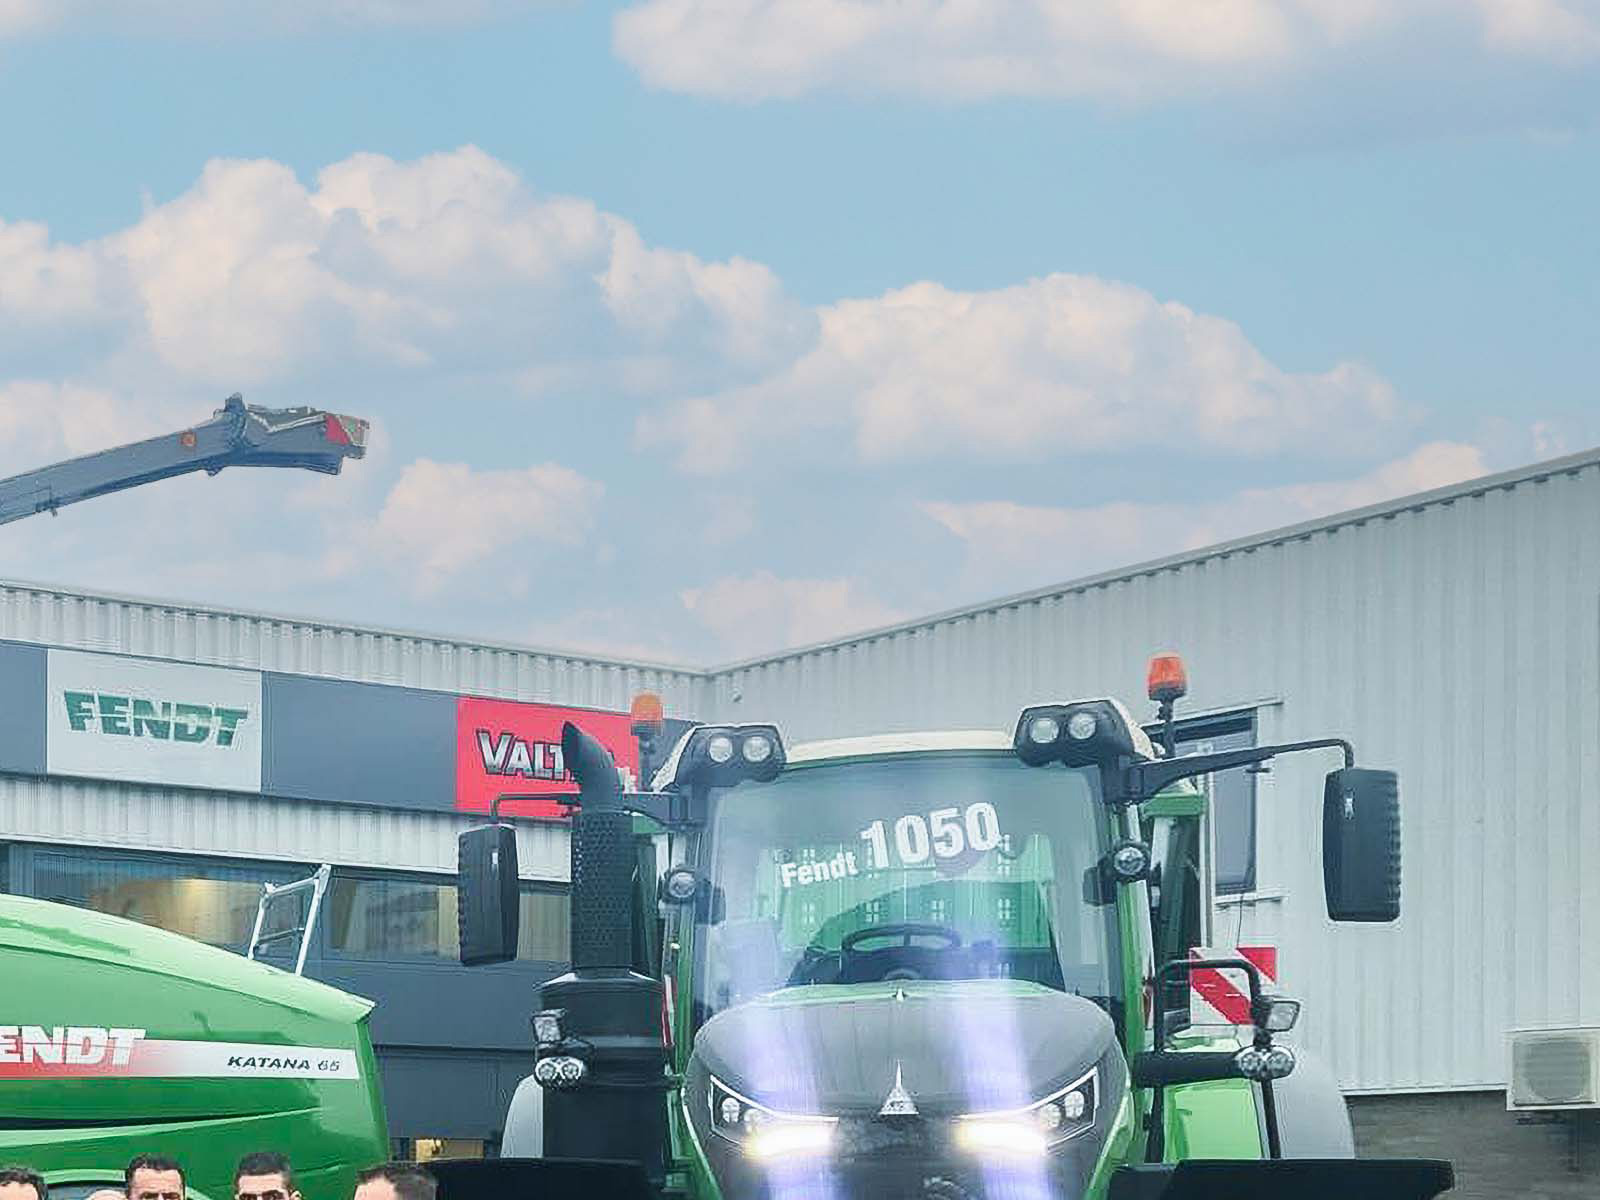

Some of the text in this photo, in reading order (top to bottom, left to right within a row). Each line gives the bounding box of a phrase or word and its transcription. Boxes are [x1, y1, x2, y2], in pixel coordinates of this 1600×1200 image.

[64, 689, 249, 747] FENDT
[475, 727, 580, 784] VALT
[780, 801, 1002, 889] Fendt 1050
[226, 1055, 311, 1071] KATANA
